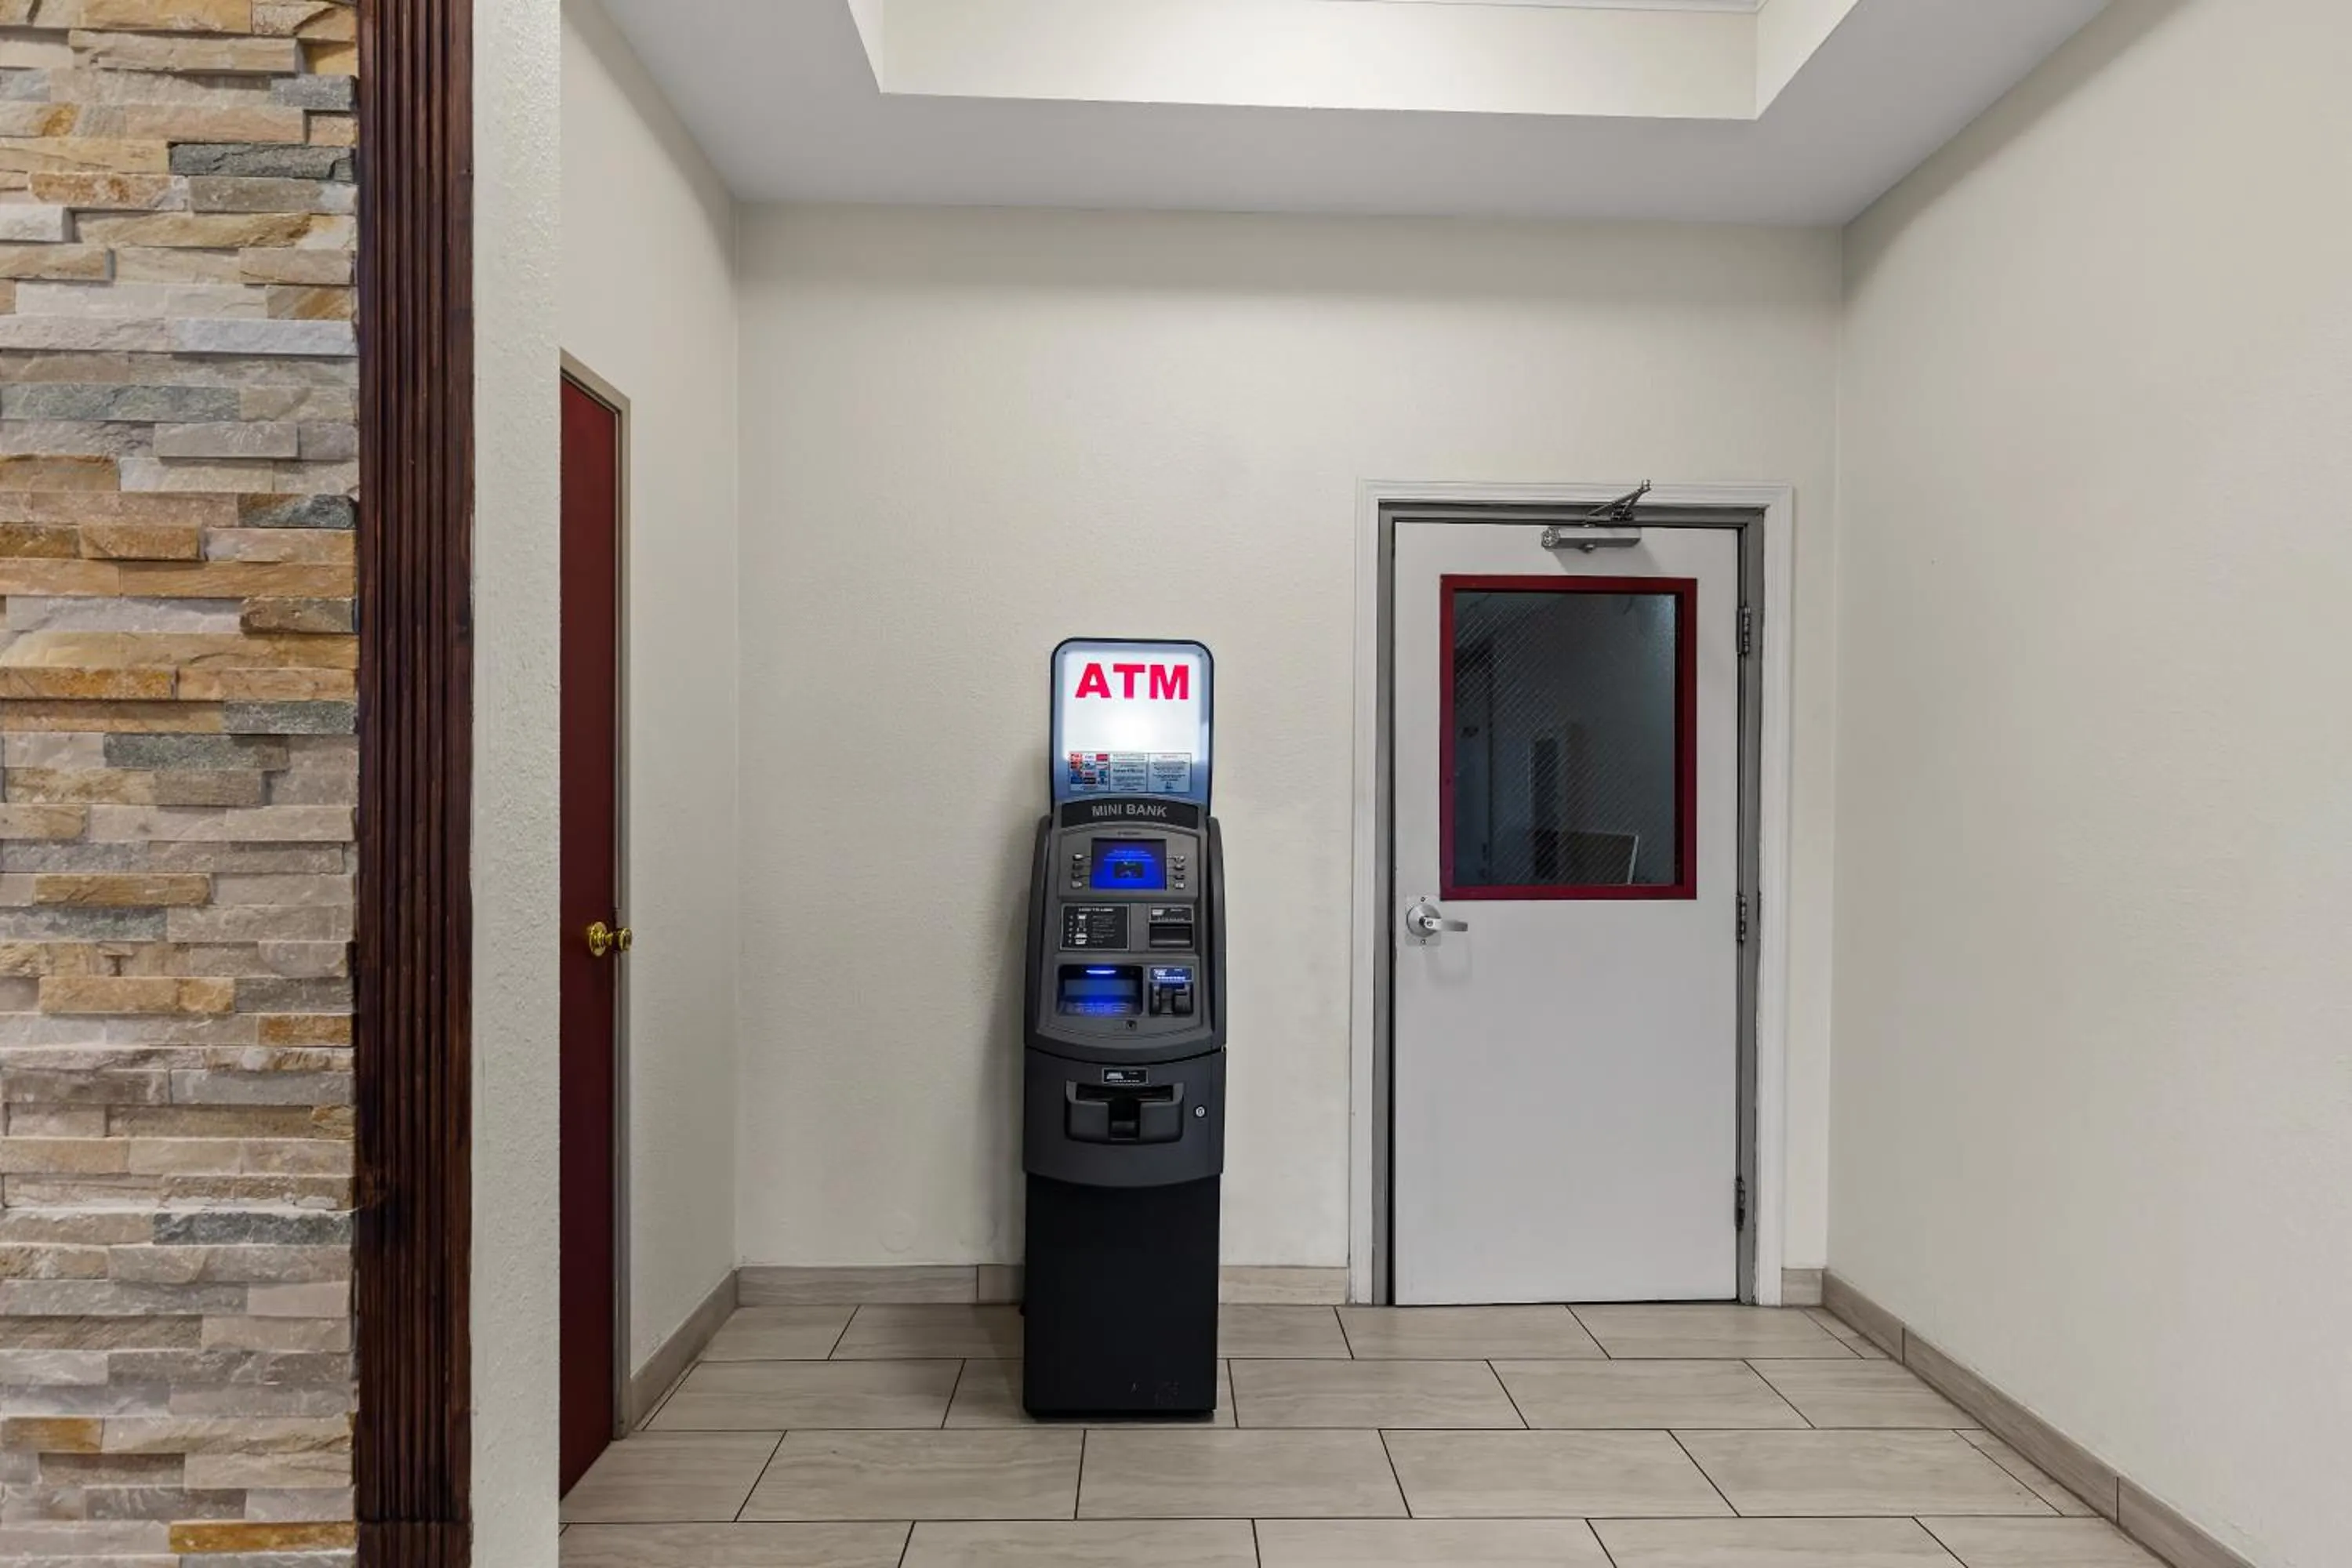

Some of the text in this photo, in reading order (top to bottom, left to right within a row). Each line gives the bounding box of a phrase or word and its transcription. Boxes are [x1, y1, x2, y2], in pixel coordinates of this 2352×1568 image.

[1075, 662, 1189, 700] ATM
[1091, 804, 1167, 818] MINI BANK
